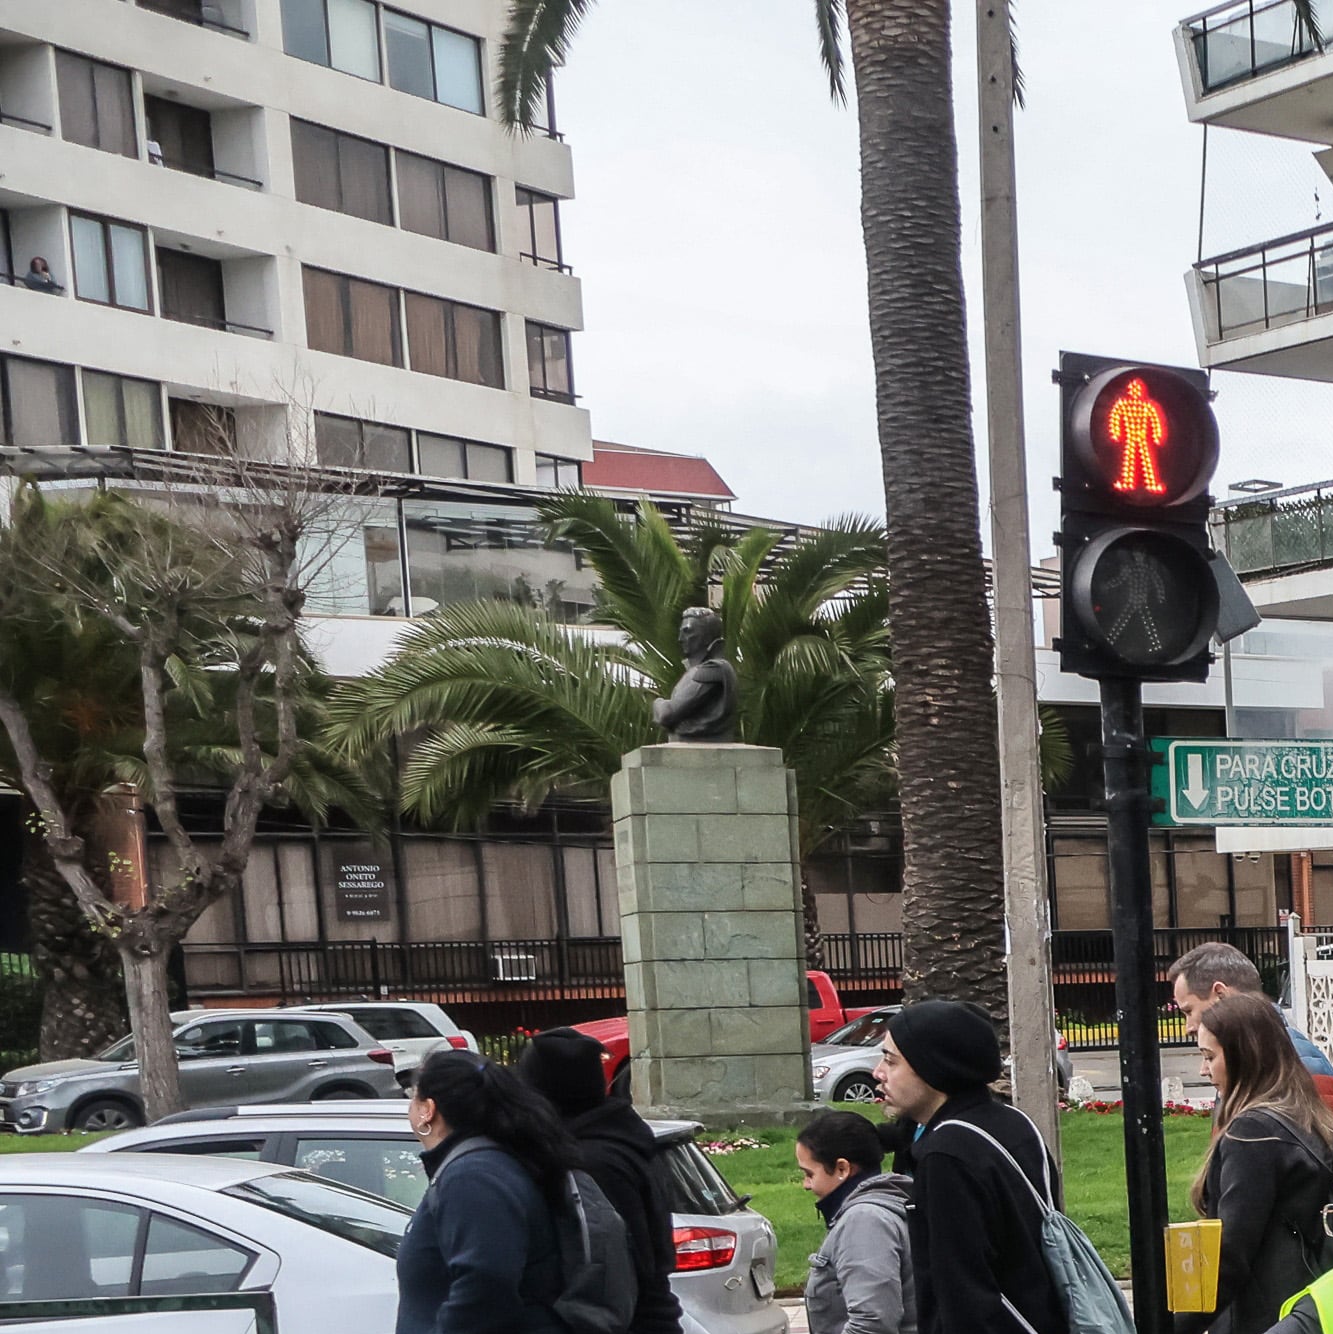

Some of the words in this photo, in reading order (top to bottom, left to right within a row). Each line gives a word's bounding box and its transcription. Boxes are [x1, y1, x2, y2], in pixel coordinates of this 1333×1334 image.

[1216, 754, 1277, 779] PARA
[1217, 786, 1290, 811] PULSE
[338, 881, 385, 889] SESSAREGO
[345, 873, 376, 881] ONETO
